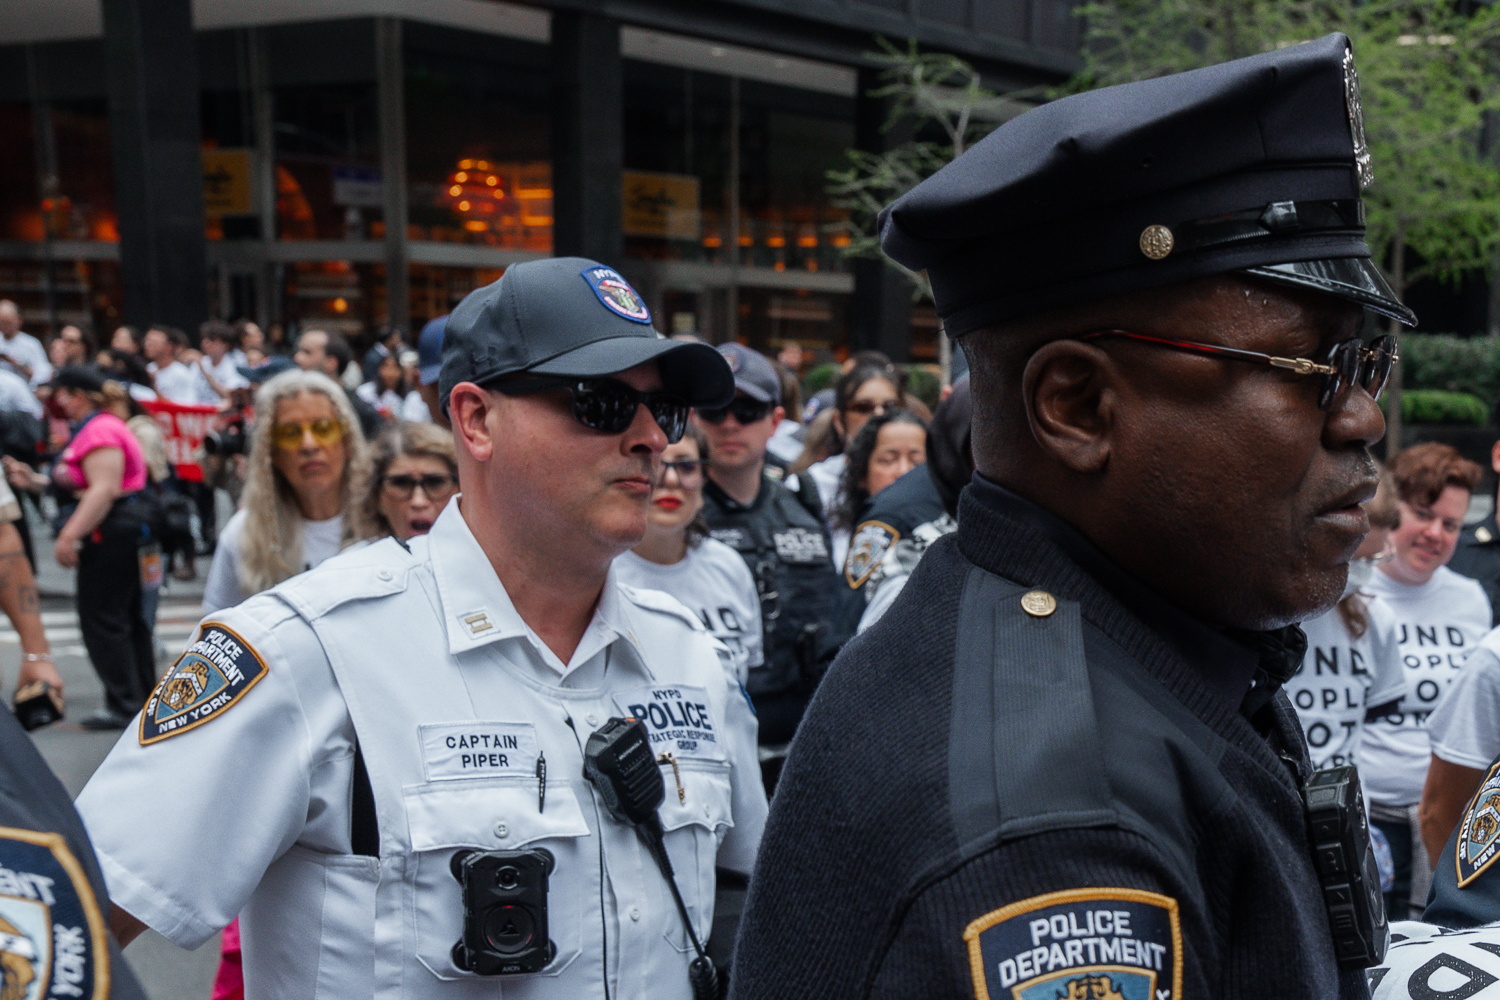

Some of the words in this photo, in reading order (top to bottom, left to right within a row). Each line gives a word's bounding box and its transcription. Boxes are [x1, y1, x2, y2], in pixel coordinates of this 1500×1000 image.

[204, 630, 243, 661] POLICE
[1399, 623, 1465, 647] UND
[652, 689, 682, 700] NYPD
[158, 715, 188, 734] NEW
[189, 691, 232, 720] YORK
[628, 701, 713, 730] POLICE
[445, 735, 518, 750] CAPTAIN
[677, 740, 698, 751] GROUP
[686, 729, 717, 743] RESPONSE
[1306, 721, 1357, 748] OT
[461, 754, 509, 769] PIPER
[1473, 845, 1496, 871] NEW
[1029, 911, 1133, 946] POLICE
[50, 922, 87, 998] YORK
[998, 937, 1167, 989] DEPARTMENT
